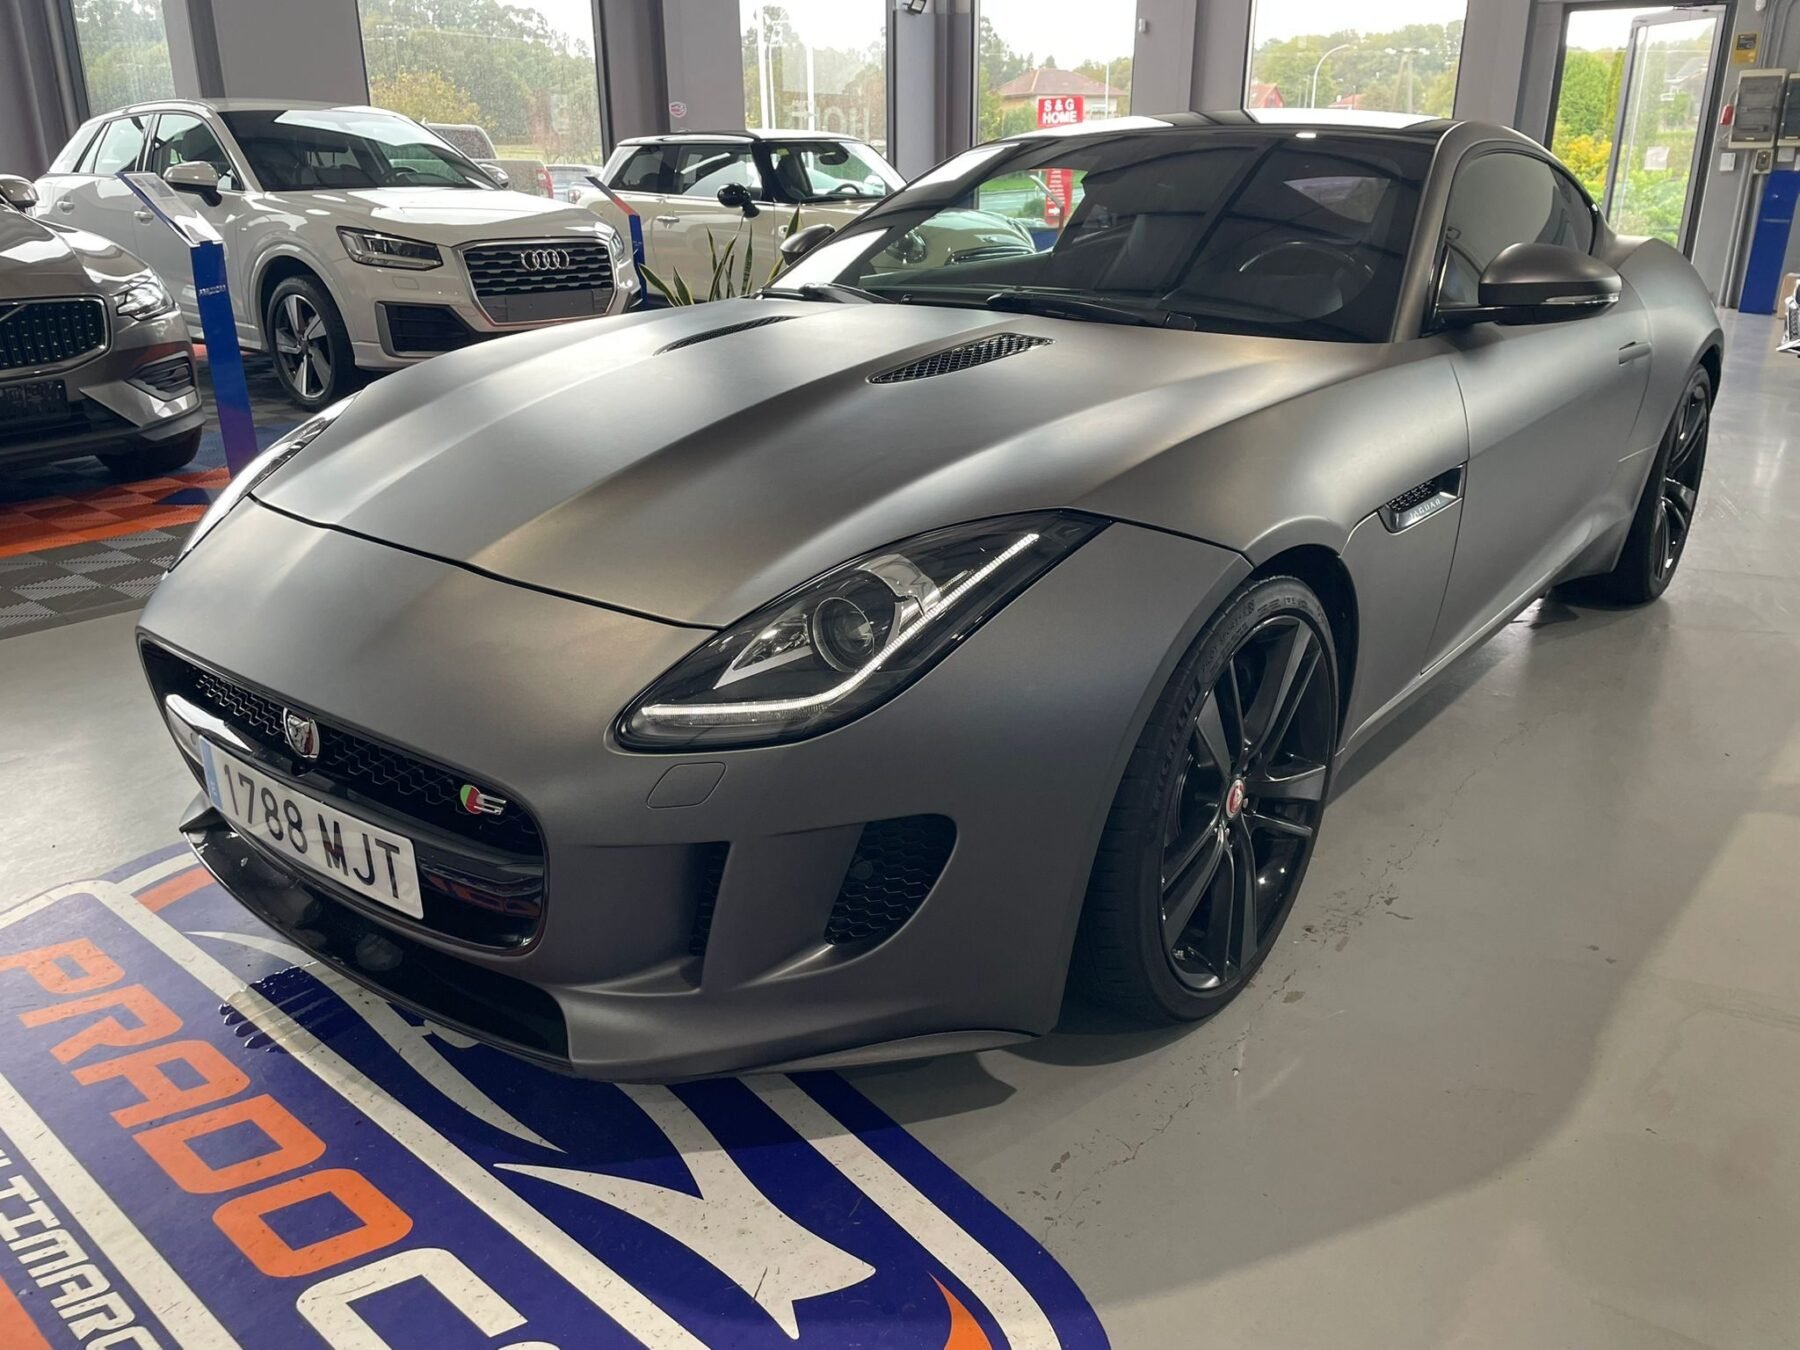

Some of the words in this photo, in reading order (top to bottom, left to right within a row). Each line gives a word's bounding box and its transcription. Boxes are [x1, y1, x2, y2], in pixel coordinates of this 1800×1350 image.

[1044, 99, 1052, 111] S
[1065, 98, 1075, 110] G
[1042, 110, 1078, 124] HOME
[1408, 498, 1441, 520] JAGUAR
[223, 763, 309, 855] 1788
[317, 813, 400, 900] MJT
[0, 937, 560, 1350] PRADOC
